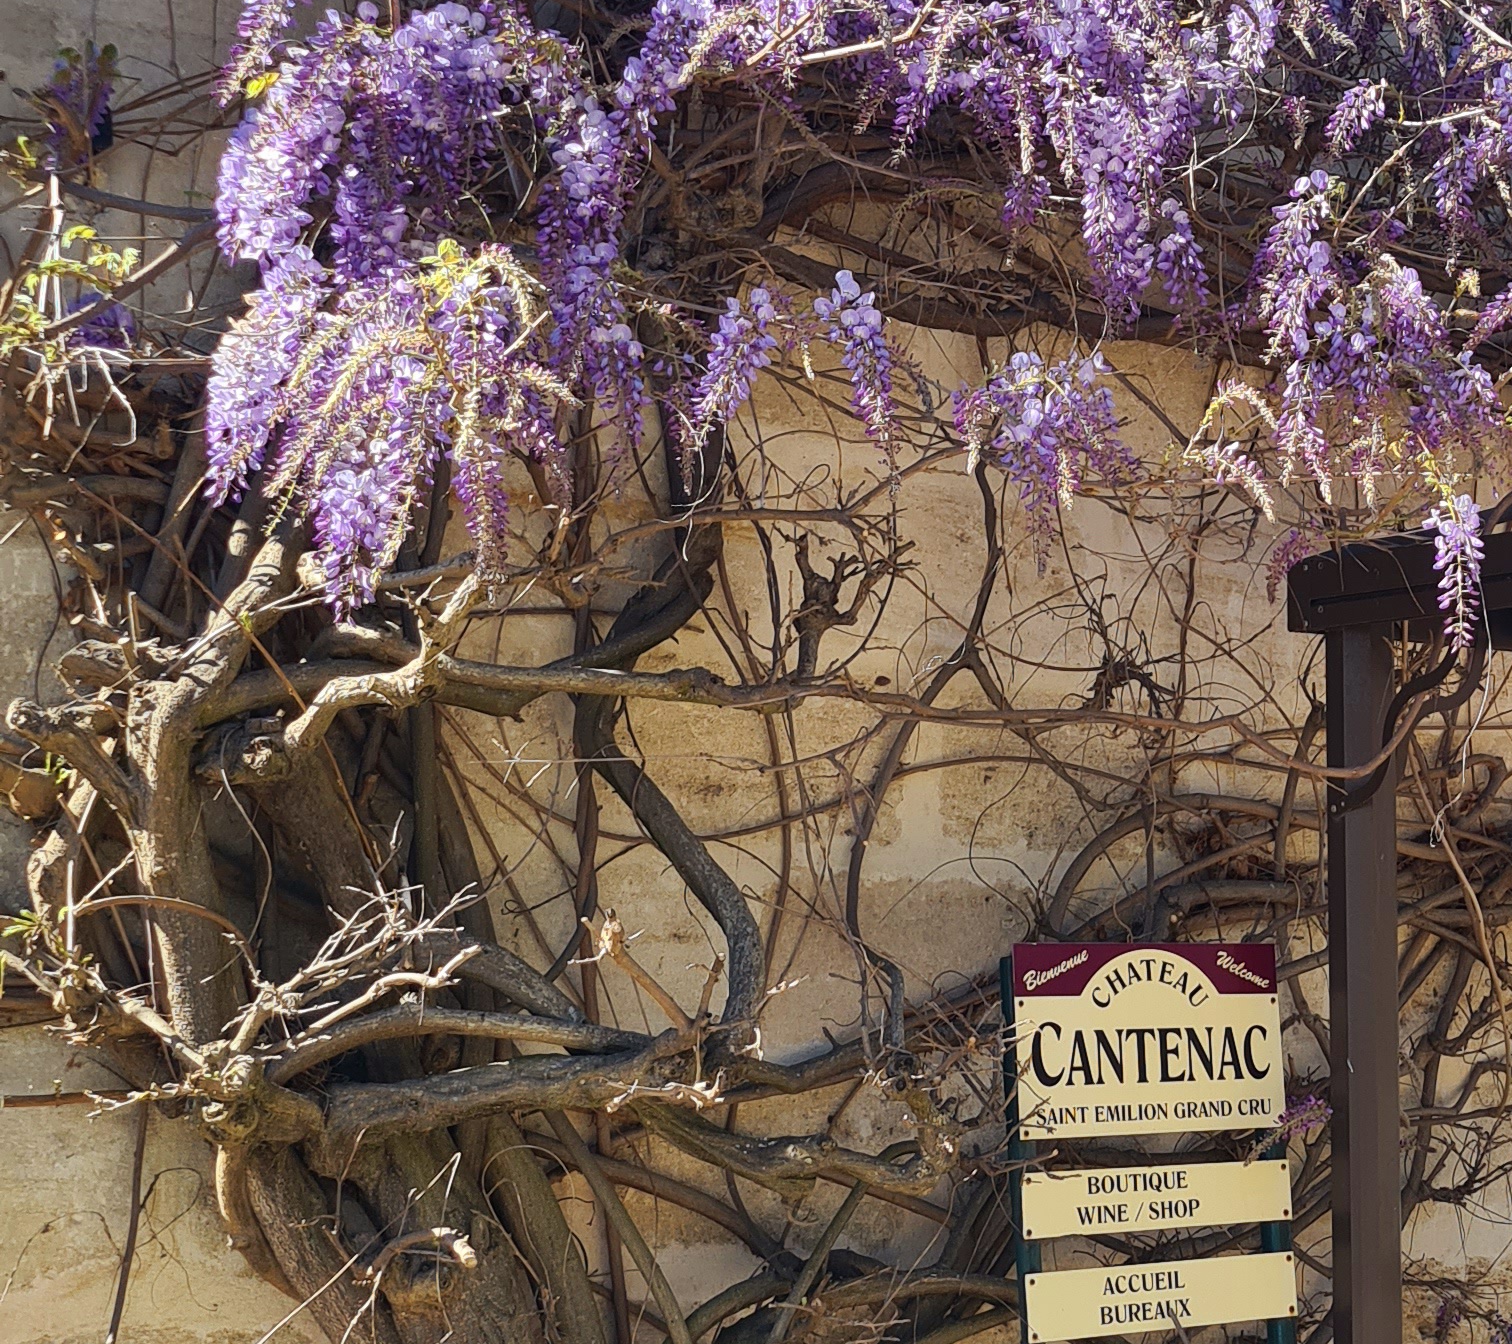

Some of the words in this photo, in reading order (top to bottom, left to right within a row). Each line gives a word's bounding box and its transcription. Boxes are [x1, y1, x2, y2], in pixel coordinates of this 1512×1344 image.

[1023, 949, 1089, 990] Bienvenue
[1216, 950, 1270, 988] Welcome
[1091, 959, 1209, 1008] CHATEAU
[1031, 1022, 1270, 1087] CANTENAC
[1036, 1106, 1089, 1126] SAINT
[1095, 1103, 1169, 1122] EMILION
[1174, 1101, 1232, 1118] GRAND
[1238, 1099, 1271, 1115] CRU
[1088, 1170, 1188, 1195] BOUTIQUE
[1076, 1204, 1129, 1226] WINE
[1148, 1198, 1200, 1220] SHOP
[1103, 1271, 1185, 1296] ACCUEIL
[1100, 1298, 1192, 1325] BUREAUX
